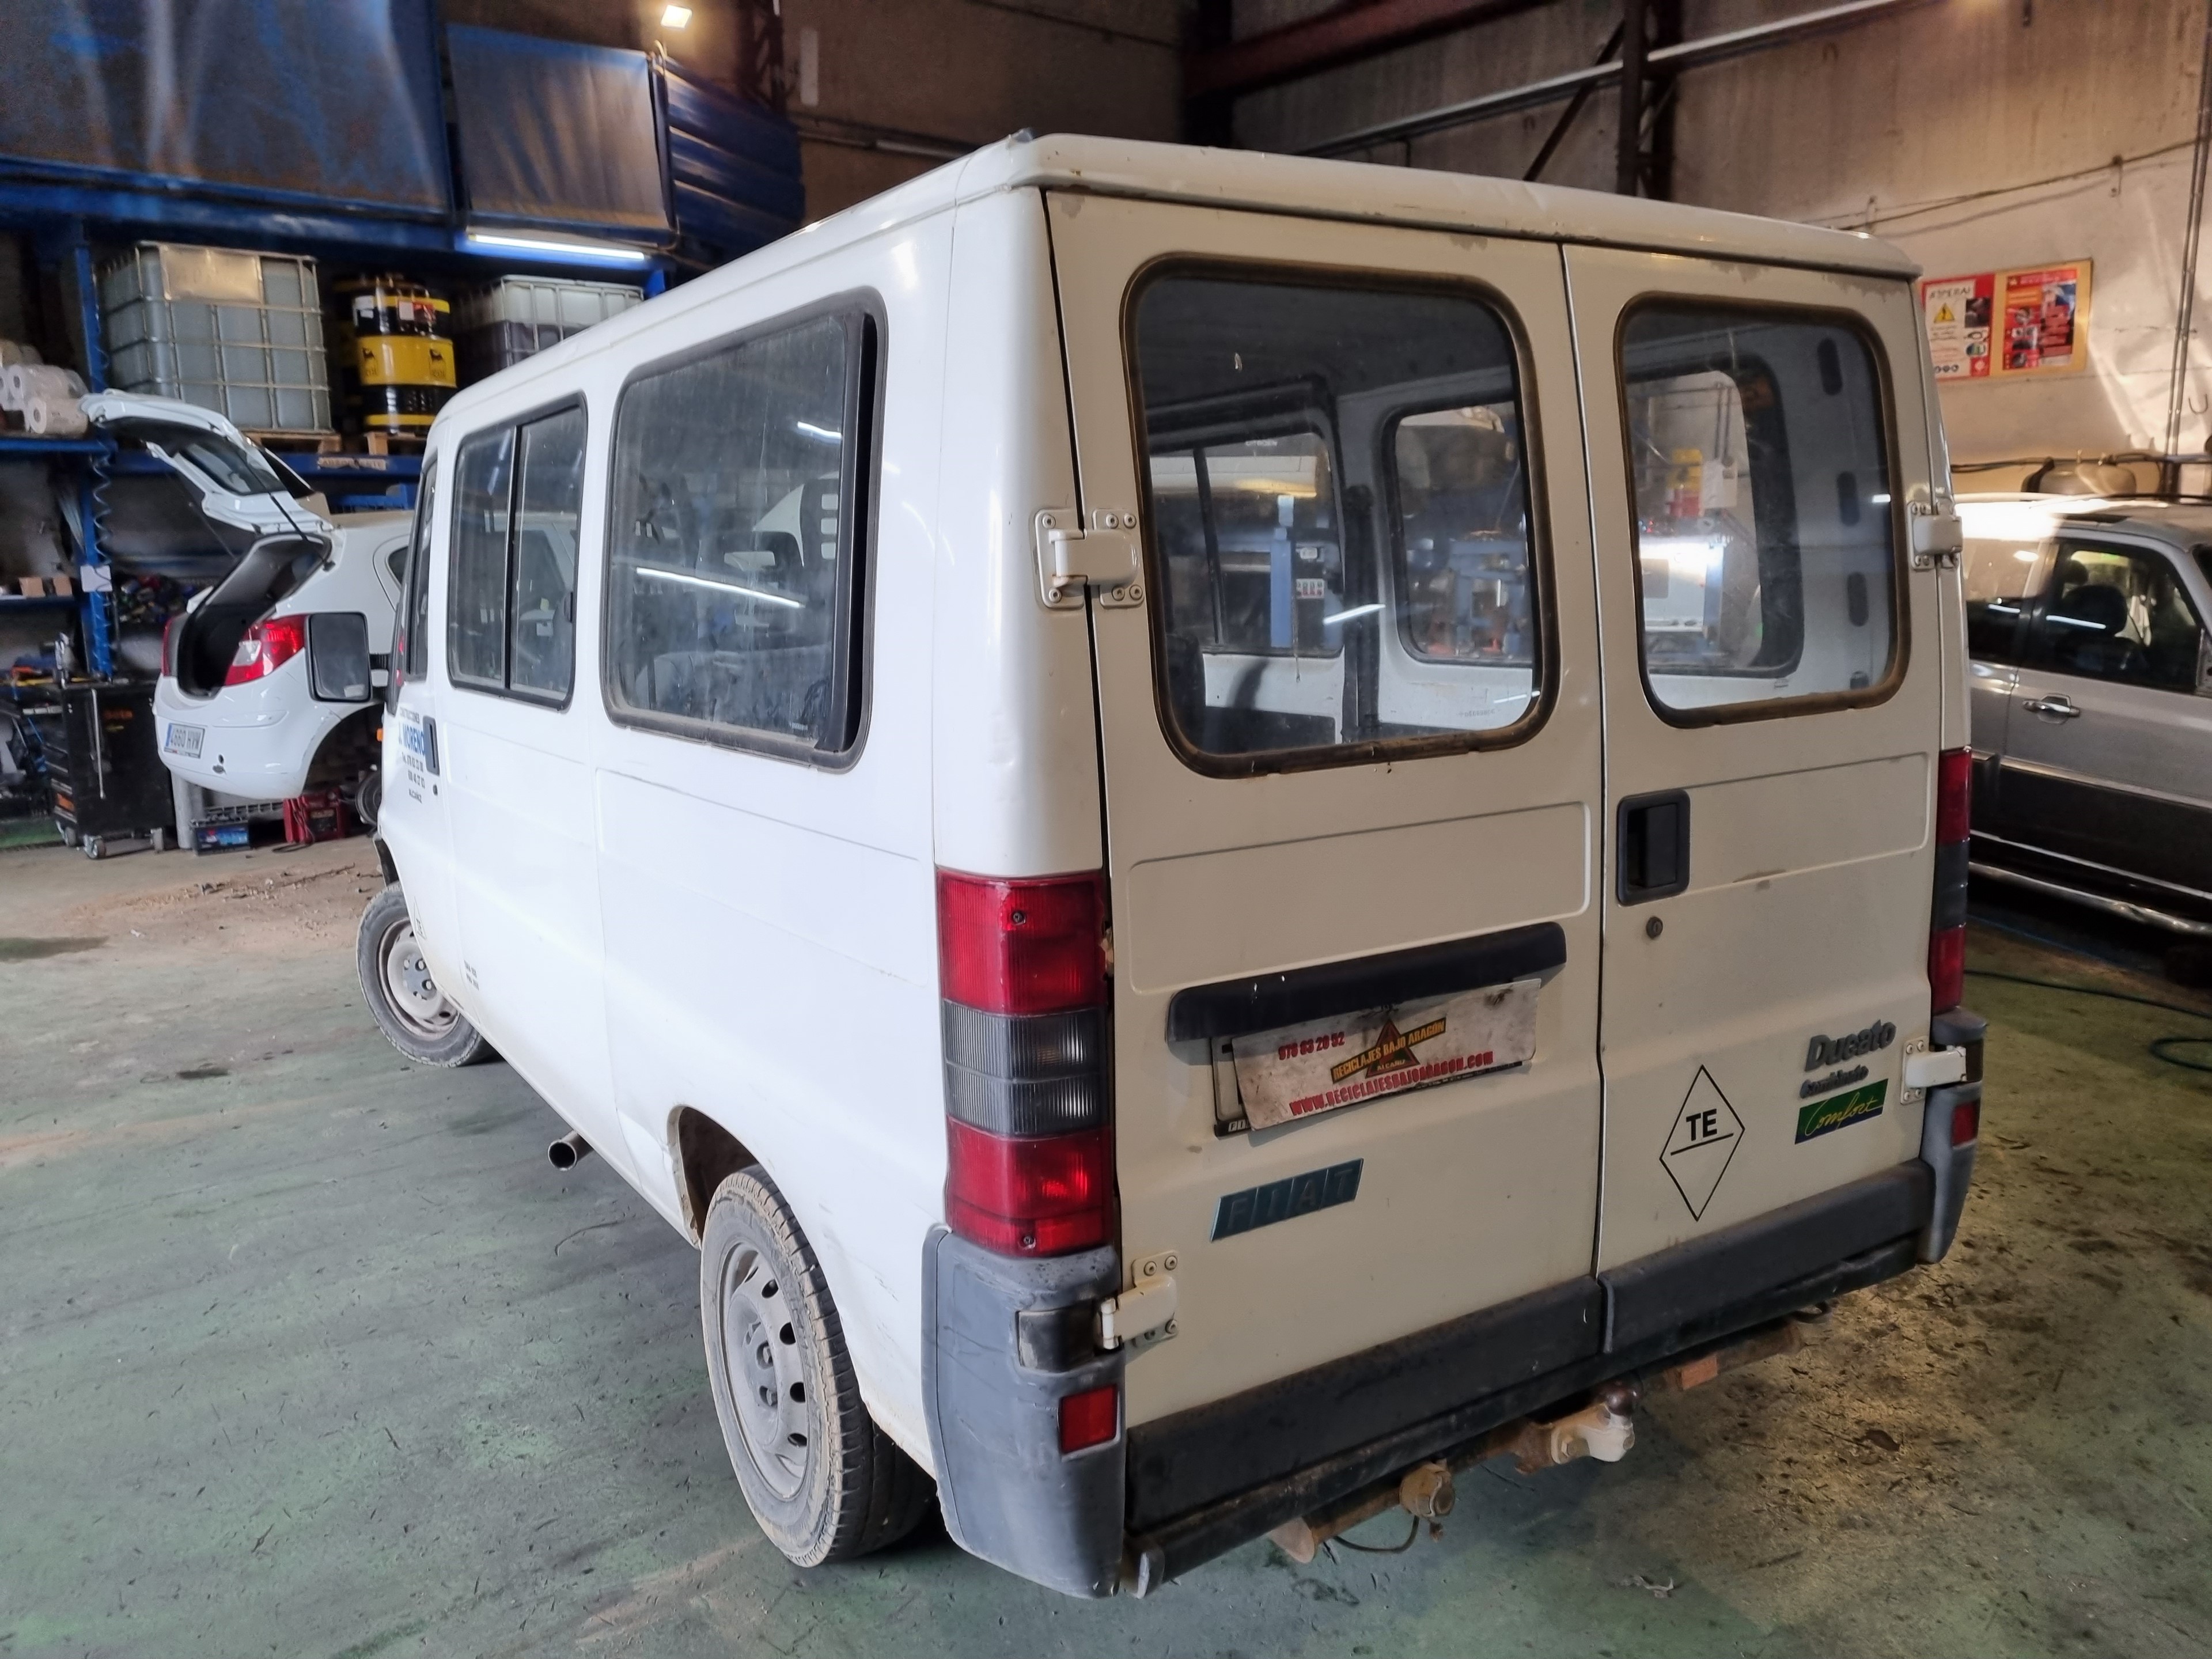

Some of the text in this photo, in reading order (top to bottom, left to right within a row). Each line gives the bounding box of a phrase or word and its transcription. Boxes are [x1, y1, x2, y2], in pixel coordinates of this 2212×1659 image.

[403, 723, 426, 756] MORENO
[1315, 1035, 1330, 1051] 20
[1331, 1031, 1345, 1047] 52
[1332, 1047, 1382, 1081] RECICLAJES
[1384, 1036, 1406, 1056] BAJO
[1804, 1018, 1897, 1072] Ducato
[1686, 1108, 1718, 1141] TE
[1805, 1092, 1879, 1136] Comfort
[1224, 1167, 1355, 1230] FIAT
